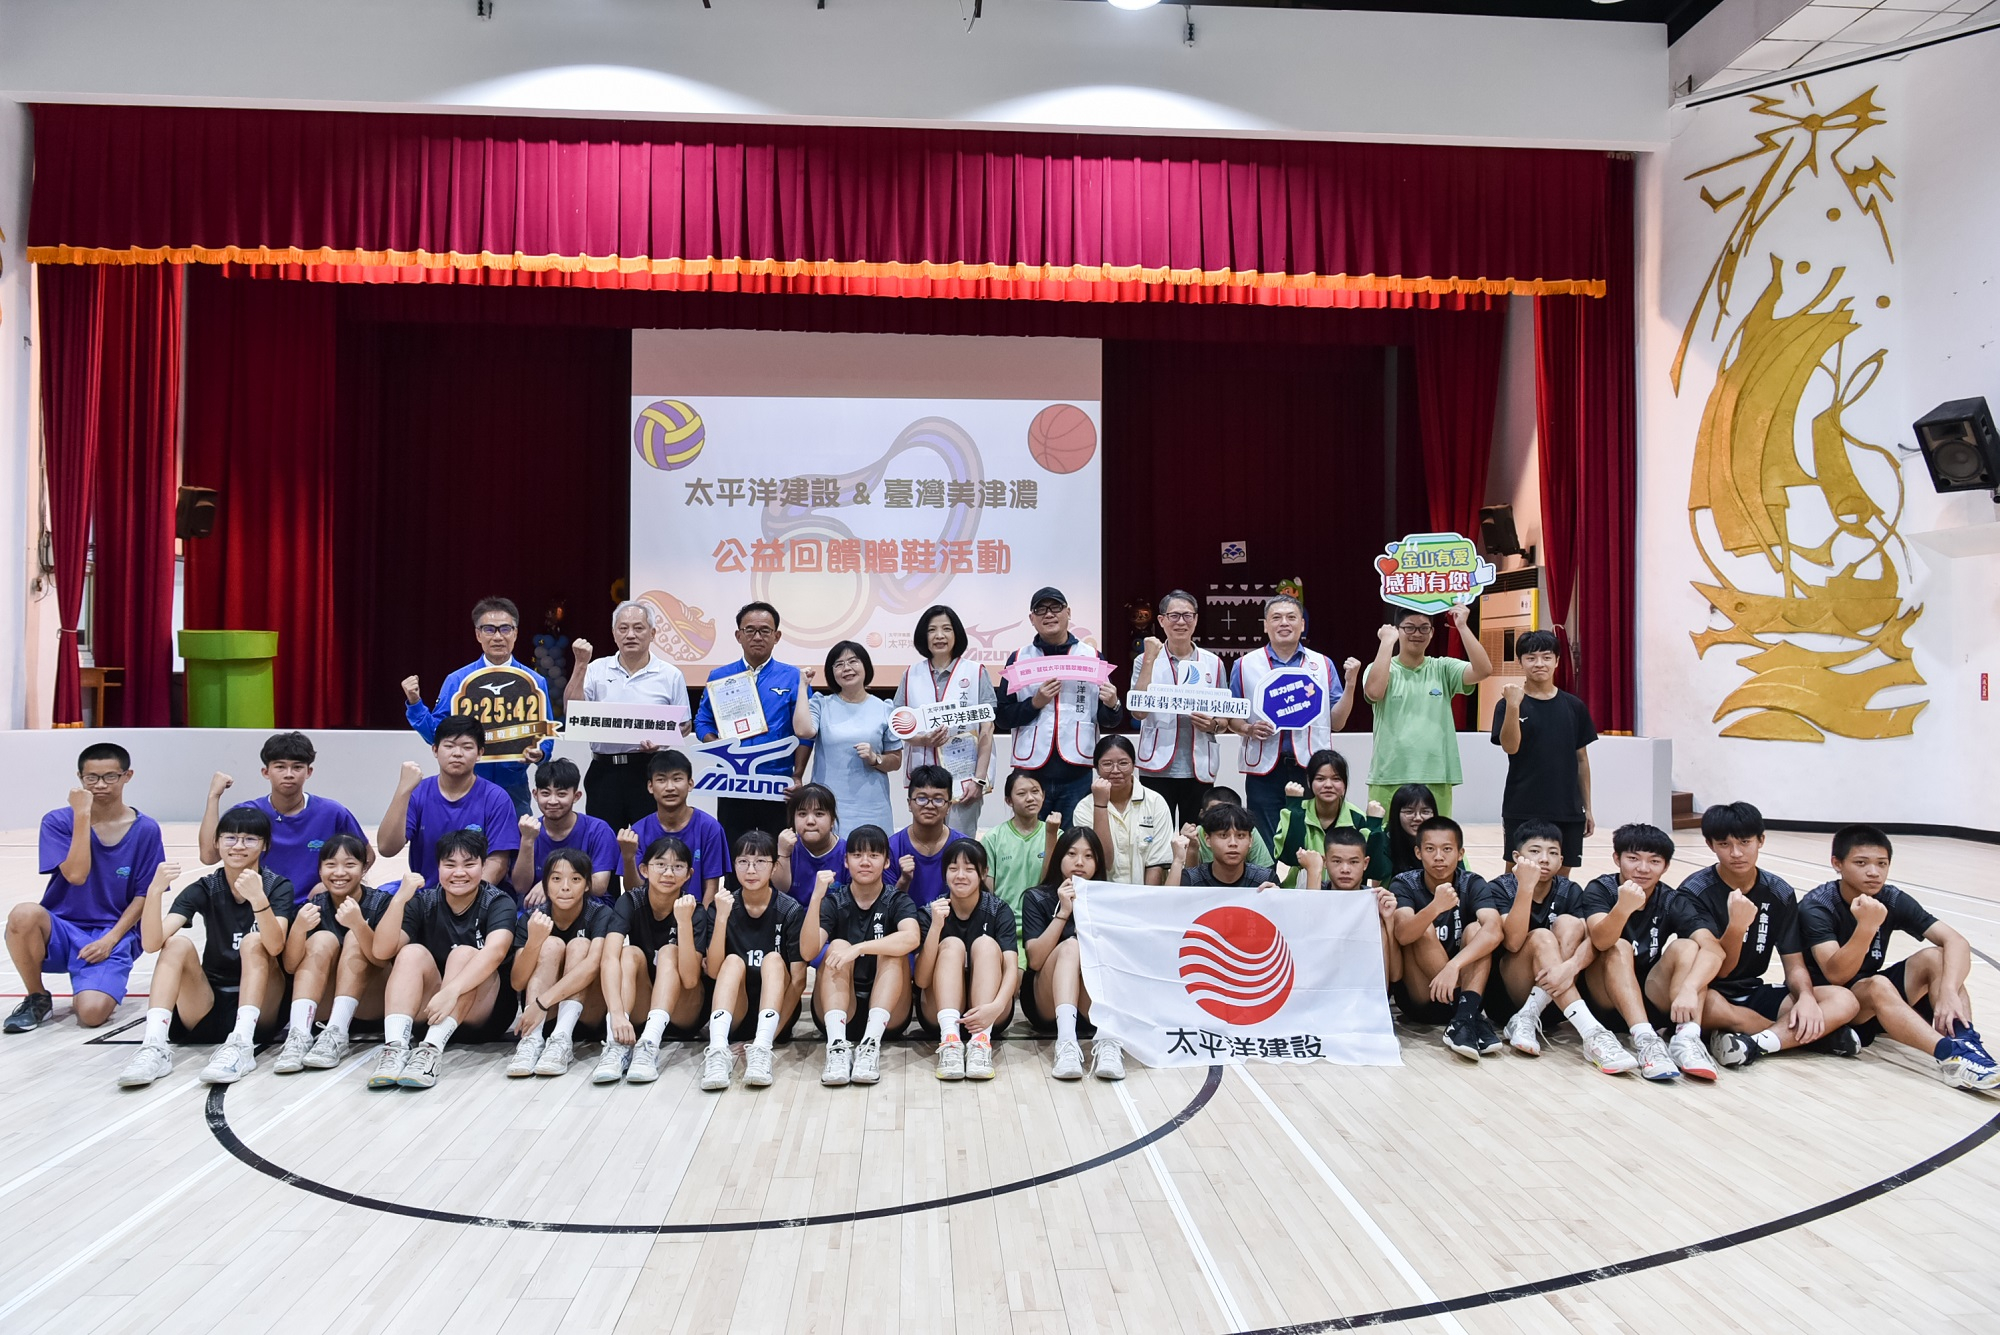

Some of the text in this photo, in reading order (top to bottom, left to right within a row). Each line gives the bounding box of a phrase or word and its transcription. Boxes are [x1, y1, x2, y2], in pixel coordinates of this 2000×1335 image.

[684, 477, 1038, 510] 太平洋建設 & 臺灣美津濃
[711, 537, 1011, 575] 公益回饋贈鞋活動
[1402, 548, 1469, 569] 金山有愛
[1384, 570, 1470, 595] 感謝有您
[927, 703, 956, 714] 太平洋集團
[929, 707, 991, 729] 太平洋建設
[569, 716, 677, 731] 中華民國體育運動總會
[693, 772, 789, 795] MIZUNO
[1756, 912, 1768, 954] 金山高中
[746, 949, 764, 967] 13
[1165, 1028, 1327, 1059] 太平洋建設
